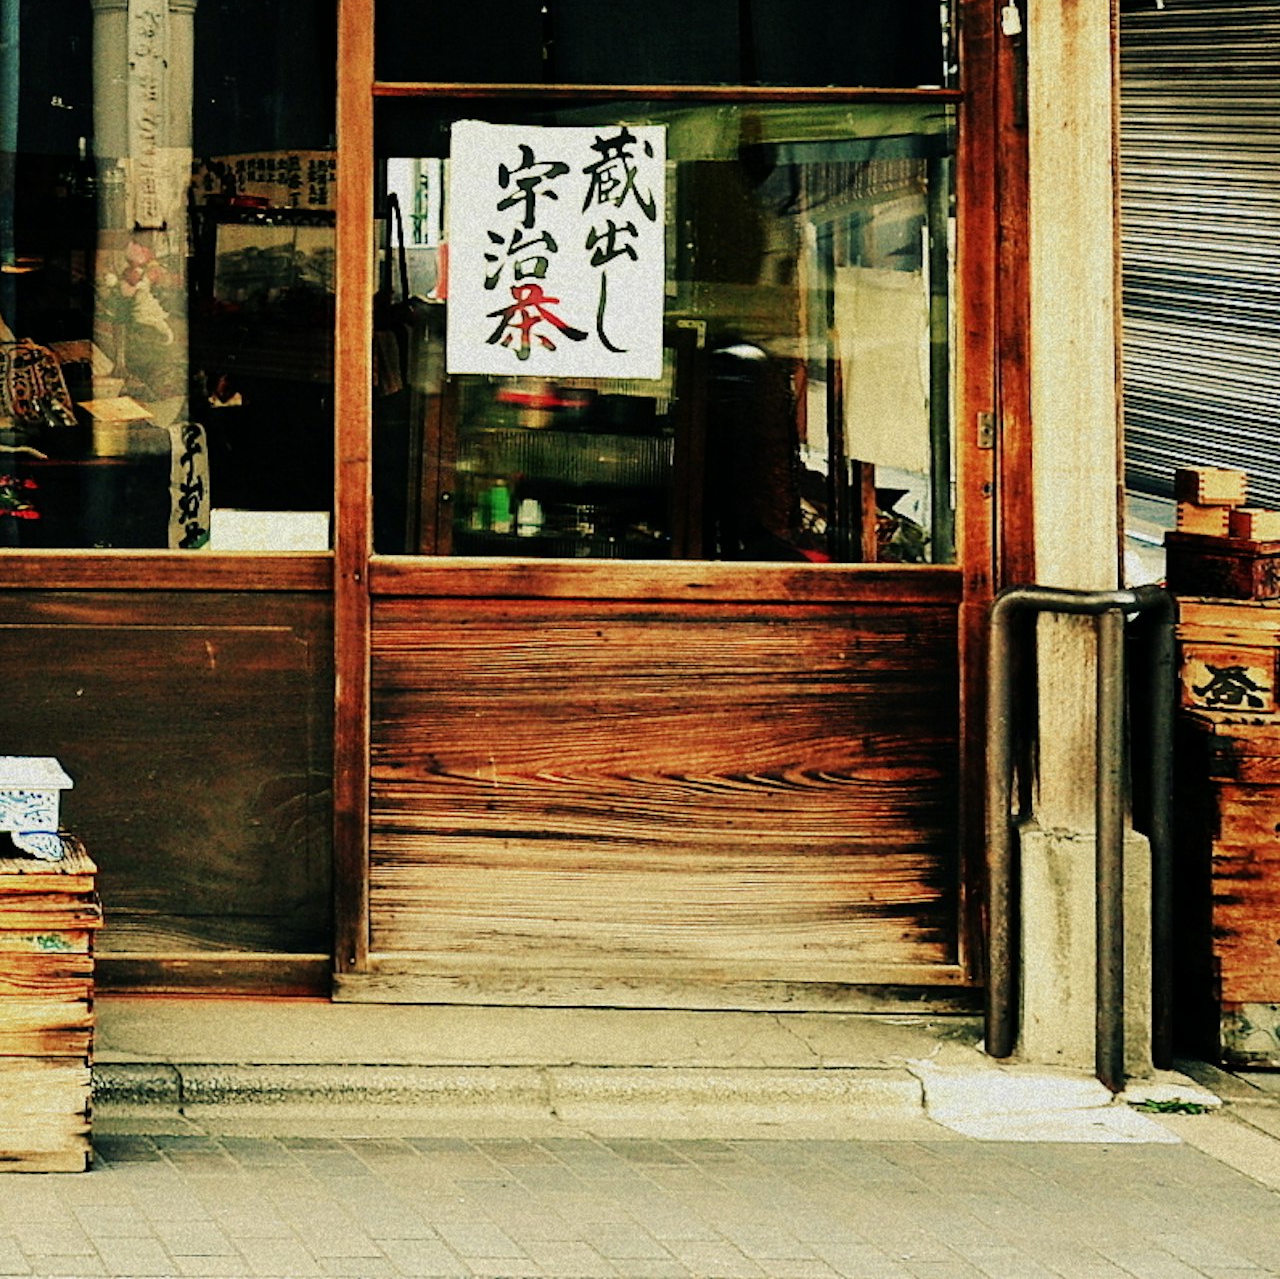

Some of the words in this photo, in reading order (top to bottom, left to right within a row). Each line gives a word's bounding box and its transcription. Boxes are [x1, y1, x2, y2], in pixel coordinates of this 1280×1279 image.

[484, 144, 589, 361] 宇治茶
[583, 127, 658, 353] 蔵出し
